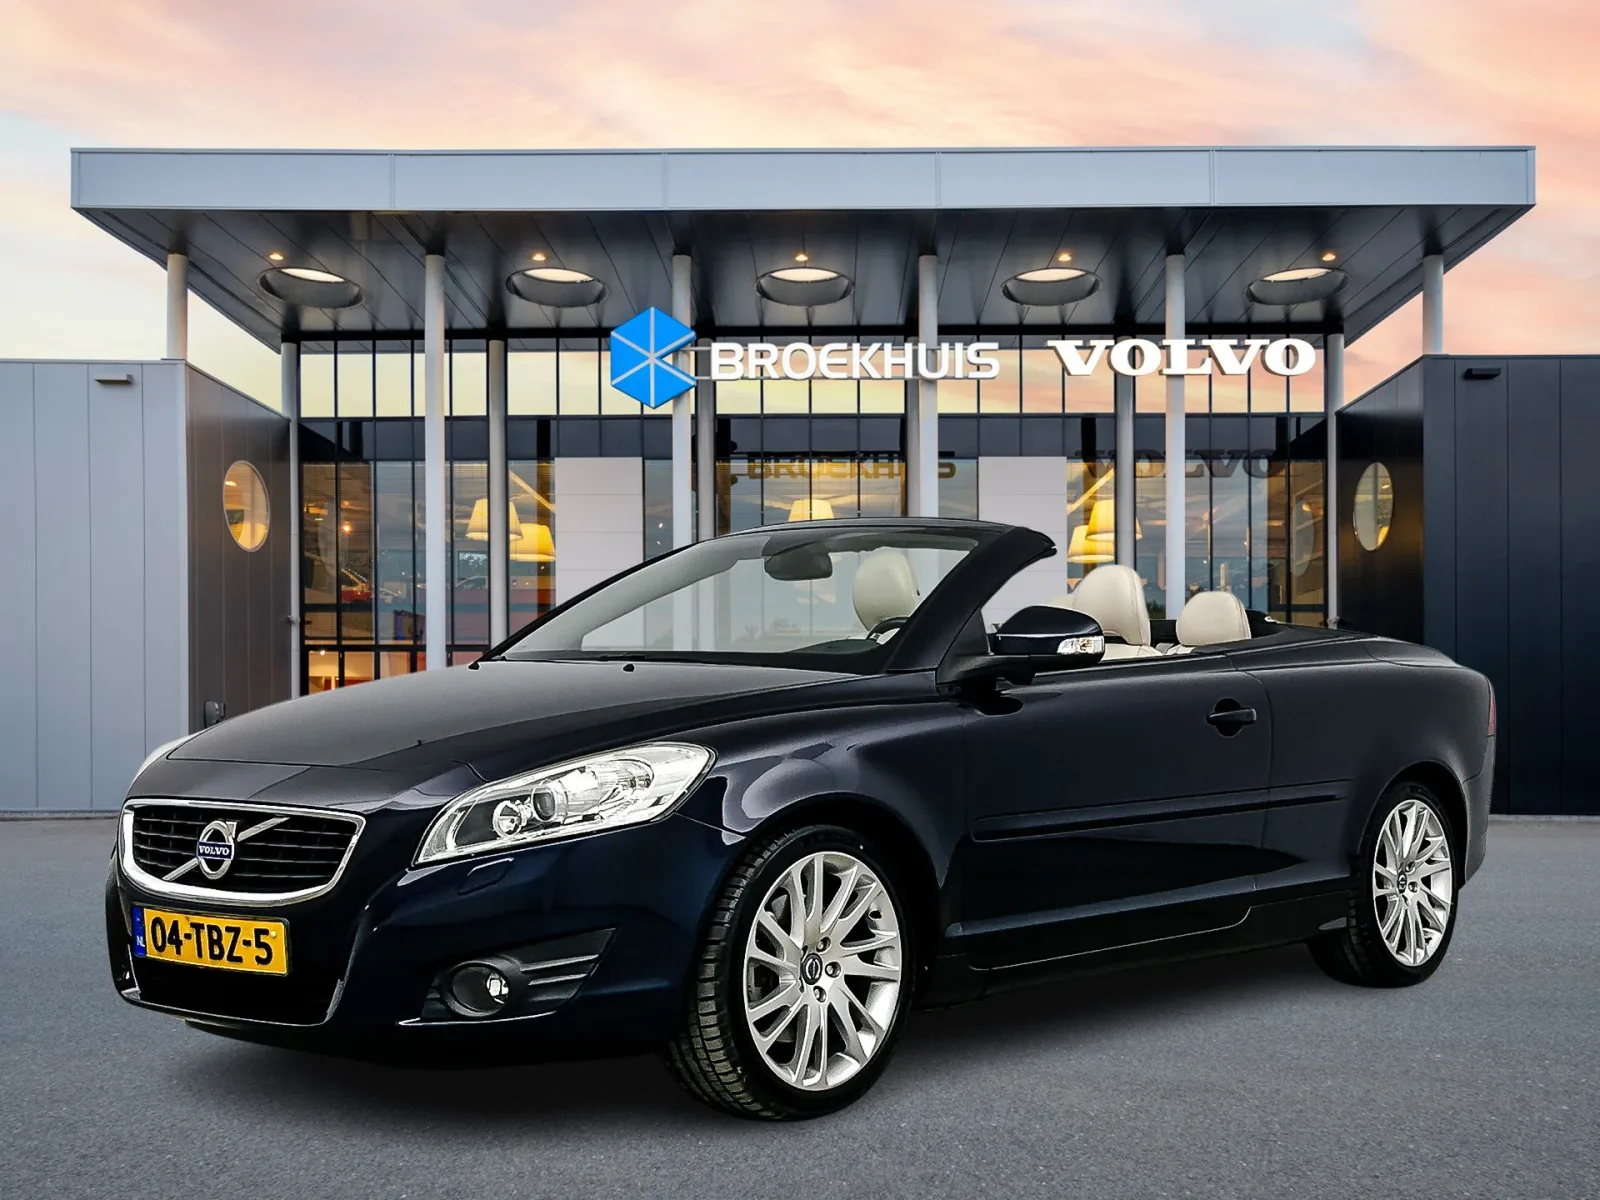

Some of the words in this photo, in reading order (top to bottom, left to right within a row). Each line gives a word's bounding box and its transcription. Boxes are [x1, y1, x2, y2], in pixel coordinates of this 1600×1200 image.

[710, 342, 1000, 380] BROEKHUIS
[1045, 338, 1316, 376] VOLVO
[198, 845, 230, 856] VOLVO
[151, 916, 273, 965] 04-TBZ-5
